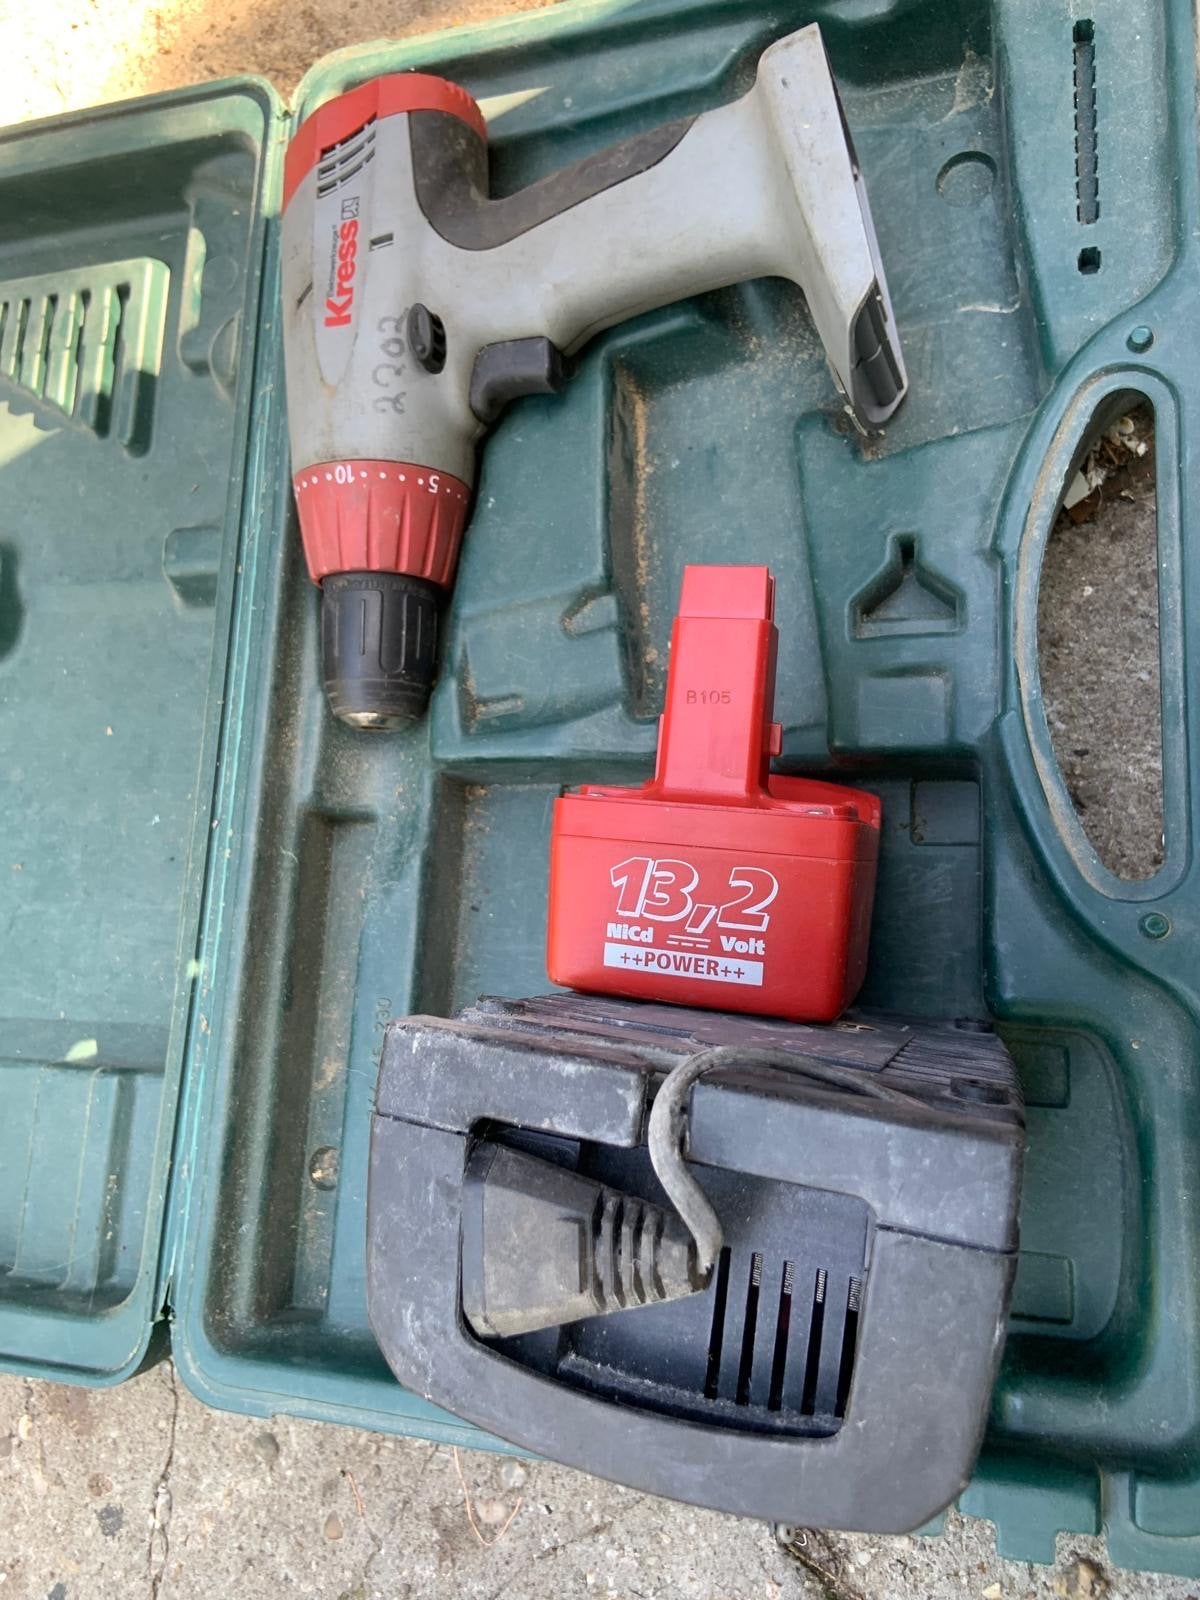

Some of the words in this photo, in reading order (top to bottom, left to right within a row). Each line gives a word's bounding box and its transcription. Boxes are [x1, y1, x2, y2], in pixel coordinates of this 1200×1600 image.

[324, 220, 359, 327] Kress
[335, 465, 355, 484] 10
[428, 475, 440, 494] 5
[686, 690, 732, 705] B105
[609, 856, 779, 934] 13,2
[606, 922, 654, 944] NiCd
[719, 935, 766, 956] Volt
